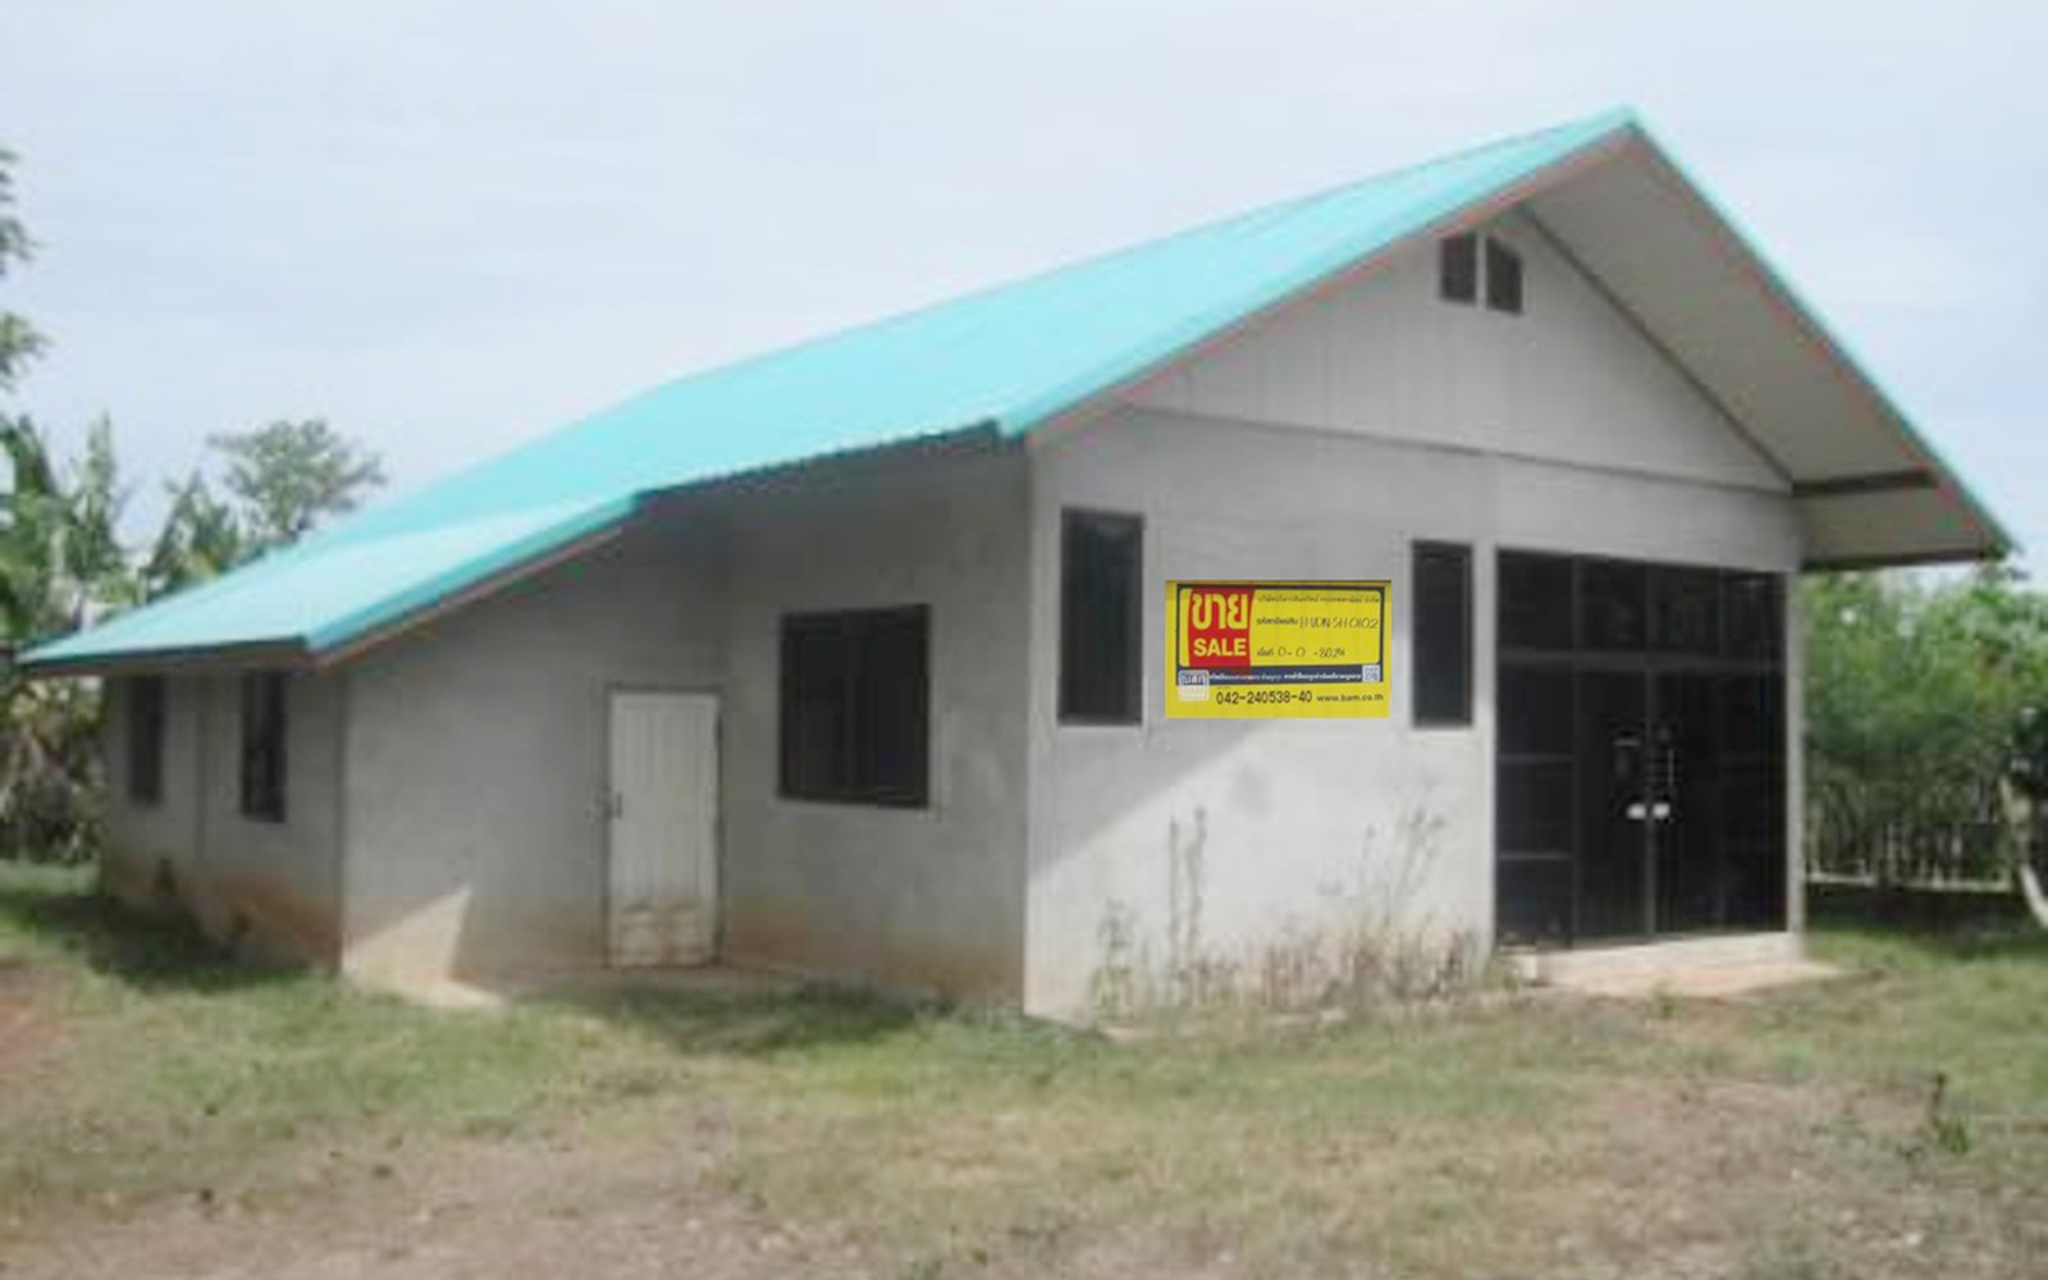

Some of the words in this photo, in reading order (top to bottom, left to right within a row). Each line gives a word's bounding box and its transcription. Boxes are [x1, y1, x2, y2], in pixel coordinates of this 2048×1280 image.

[1192, 593, 1249, 630] ขาย
[1193, 638, 1248, 657] SALE
[1216, 690, 1313, 705] 042-240538-40
[1316, 693, 1384, 703] www.bam.co.th
